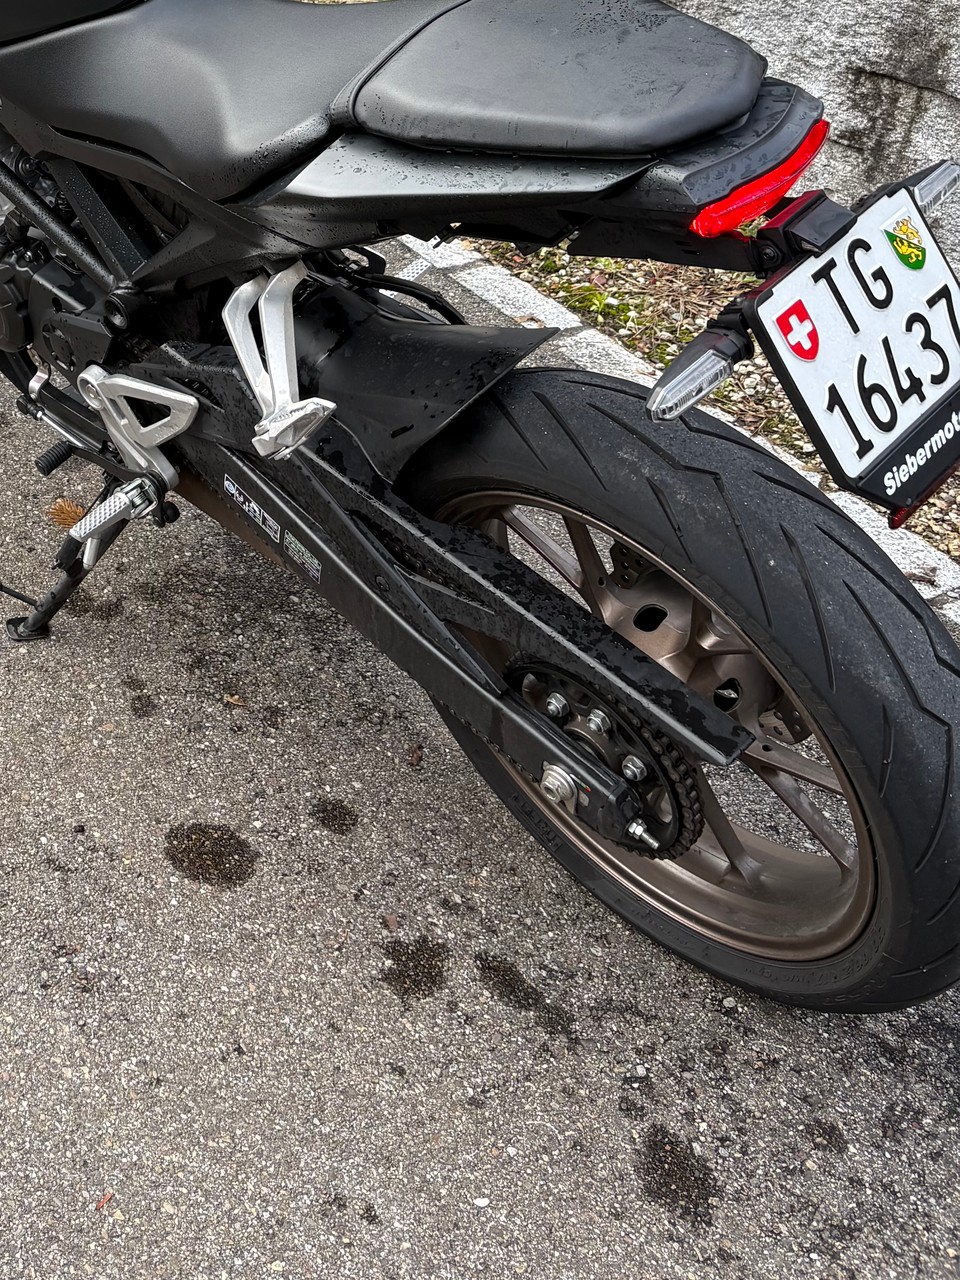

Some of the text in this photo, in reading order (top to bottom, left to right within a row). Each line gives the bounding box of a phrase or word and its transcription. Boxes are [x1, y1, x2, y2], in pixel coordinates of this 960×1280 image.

[811, 238, 893, 335] TG
[826, 283, 960, 460] 16437
[883, 410, 960, 496] Siebermot
